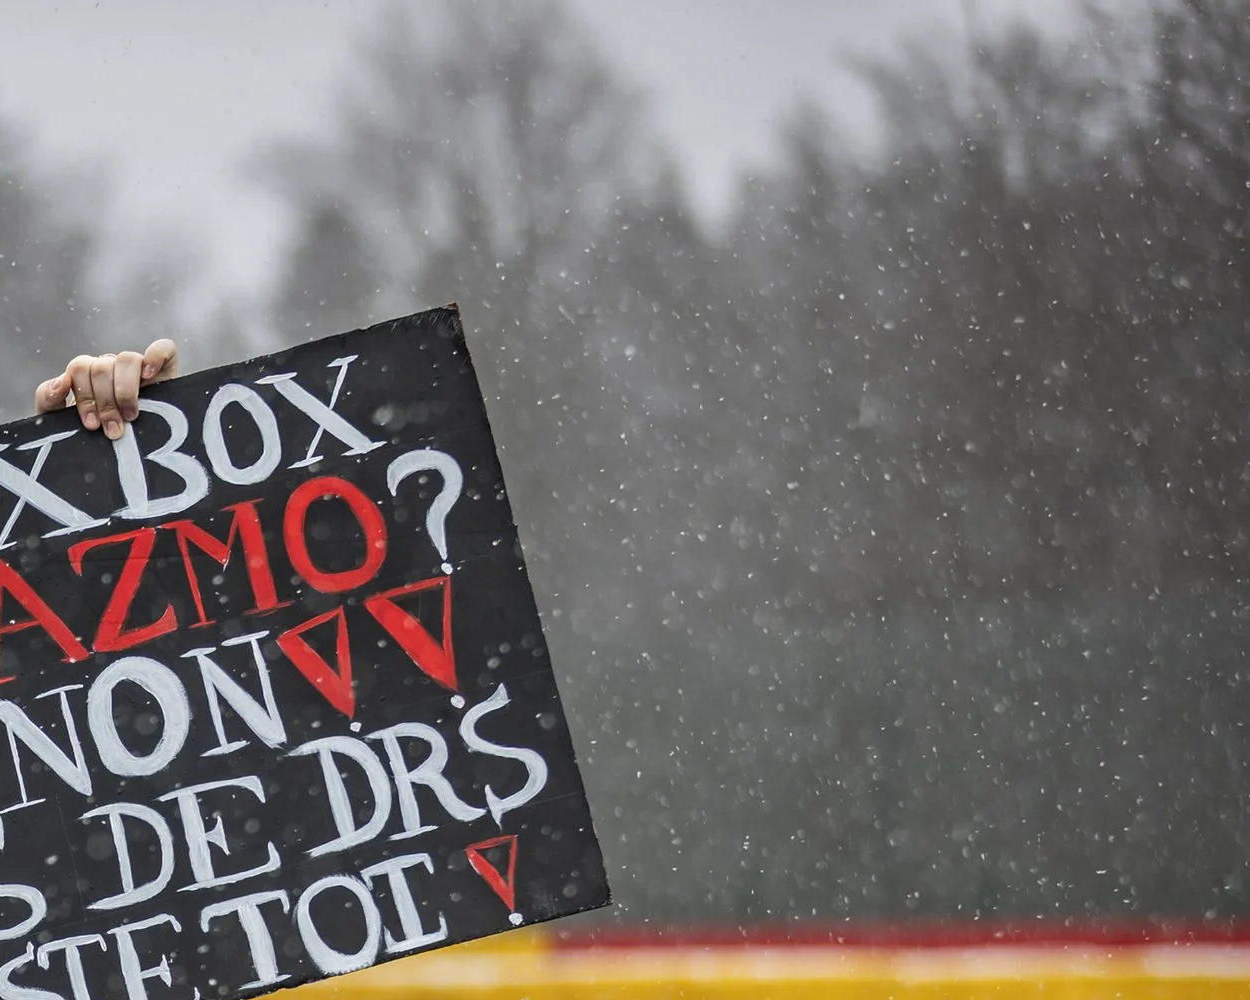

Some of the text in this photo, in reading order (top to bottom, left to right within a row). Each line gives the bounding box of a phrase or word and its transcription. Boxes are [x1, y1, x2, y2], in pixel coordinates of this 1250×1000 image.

[111, 355, 387, 520] BOX
[78, 776, 281, 910] DE
[288, 683, 549, 857] DRS
[201, 853, 448, 990] TOI
